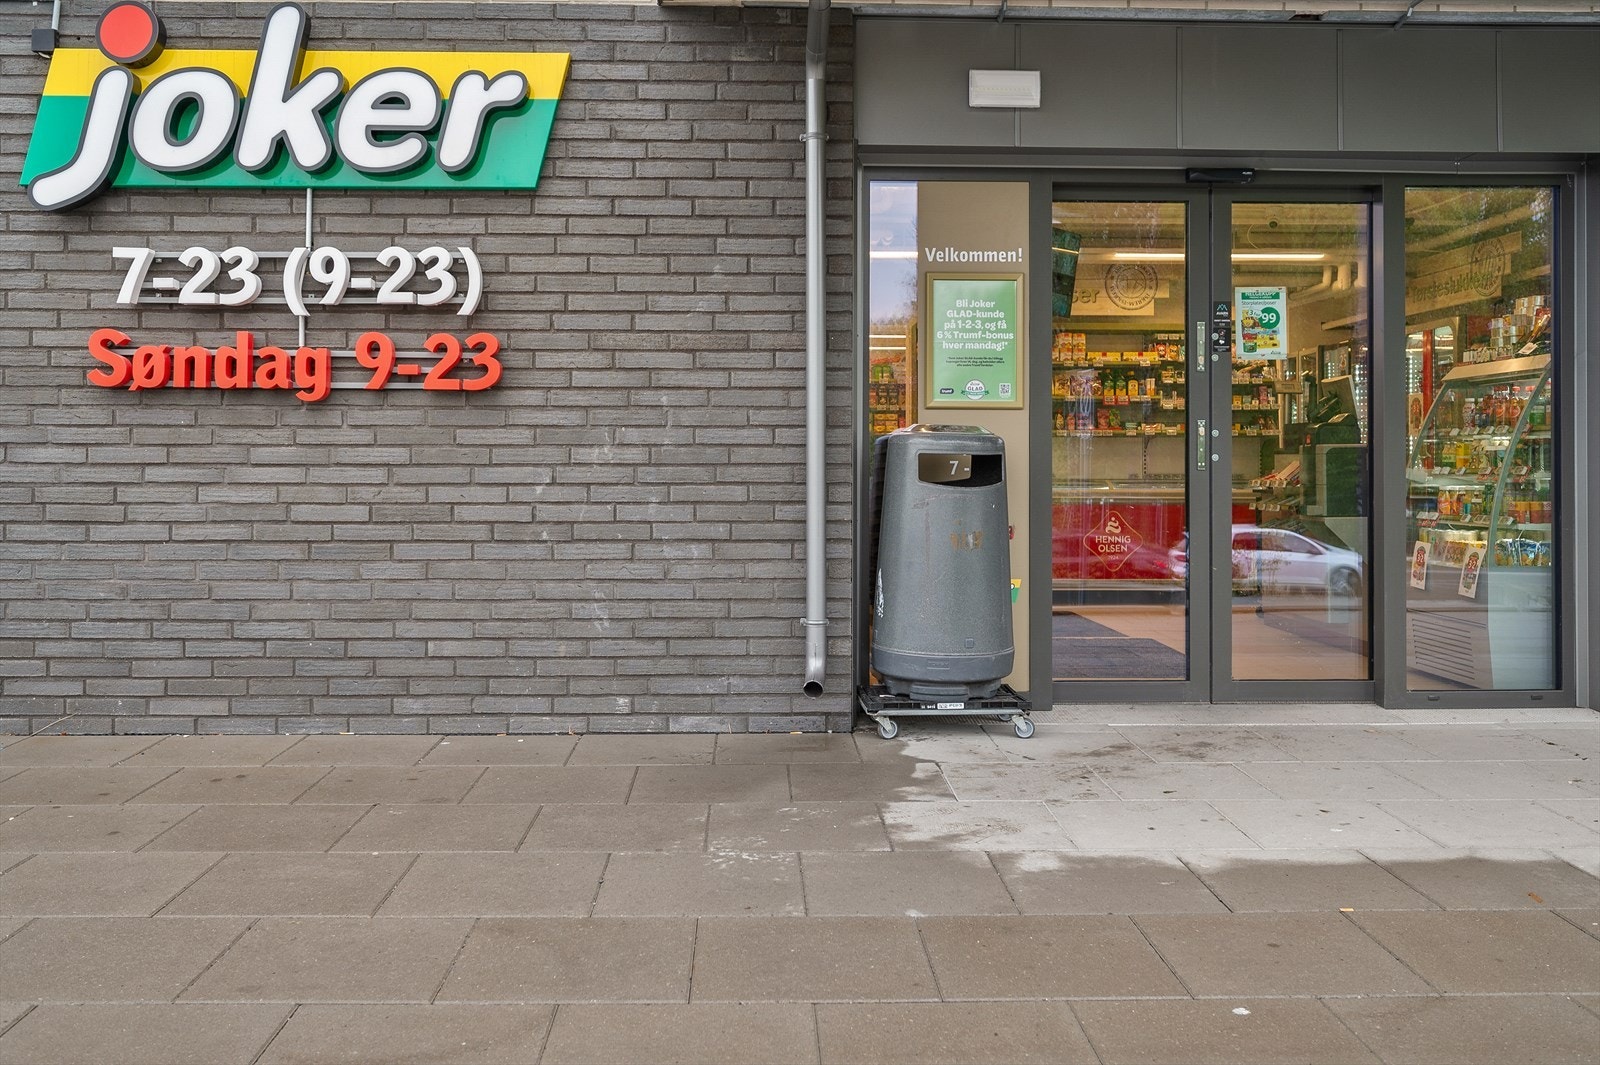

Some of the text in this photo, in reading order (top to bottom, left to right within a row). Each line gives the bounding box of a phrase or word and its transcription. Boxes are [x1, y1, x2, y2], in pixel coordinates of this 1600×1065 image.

[28, 1, 530, 211] joker
[924, 247, 1023, 262] Velkommen!
[112, 246, 483, 316] 7-23 (9-23)
[956, 299, 996, 308] Bli Joker
[946, 309, 1005, 318] GLAD-kunde
[1261, 312, 1277, 323] 99
[944, 319, 1007, 331] på 1-2-3, og få
[936, 330, 1014, 339] 6 % Trumf-bonus
[942, 341, 964, 349] hver
[87, 328, 503, 402] Søndag 9-23
[949, 460, 959, 475] 7
[1095, 535, 1131, 543] HENNIG
[1098, 544, 1127, 552] OLSEN
